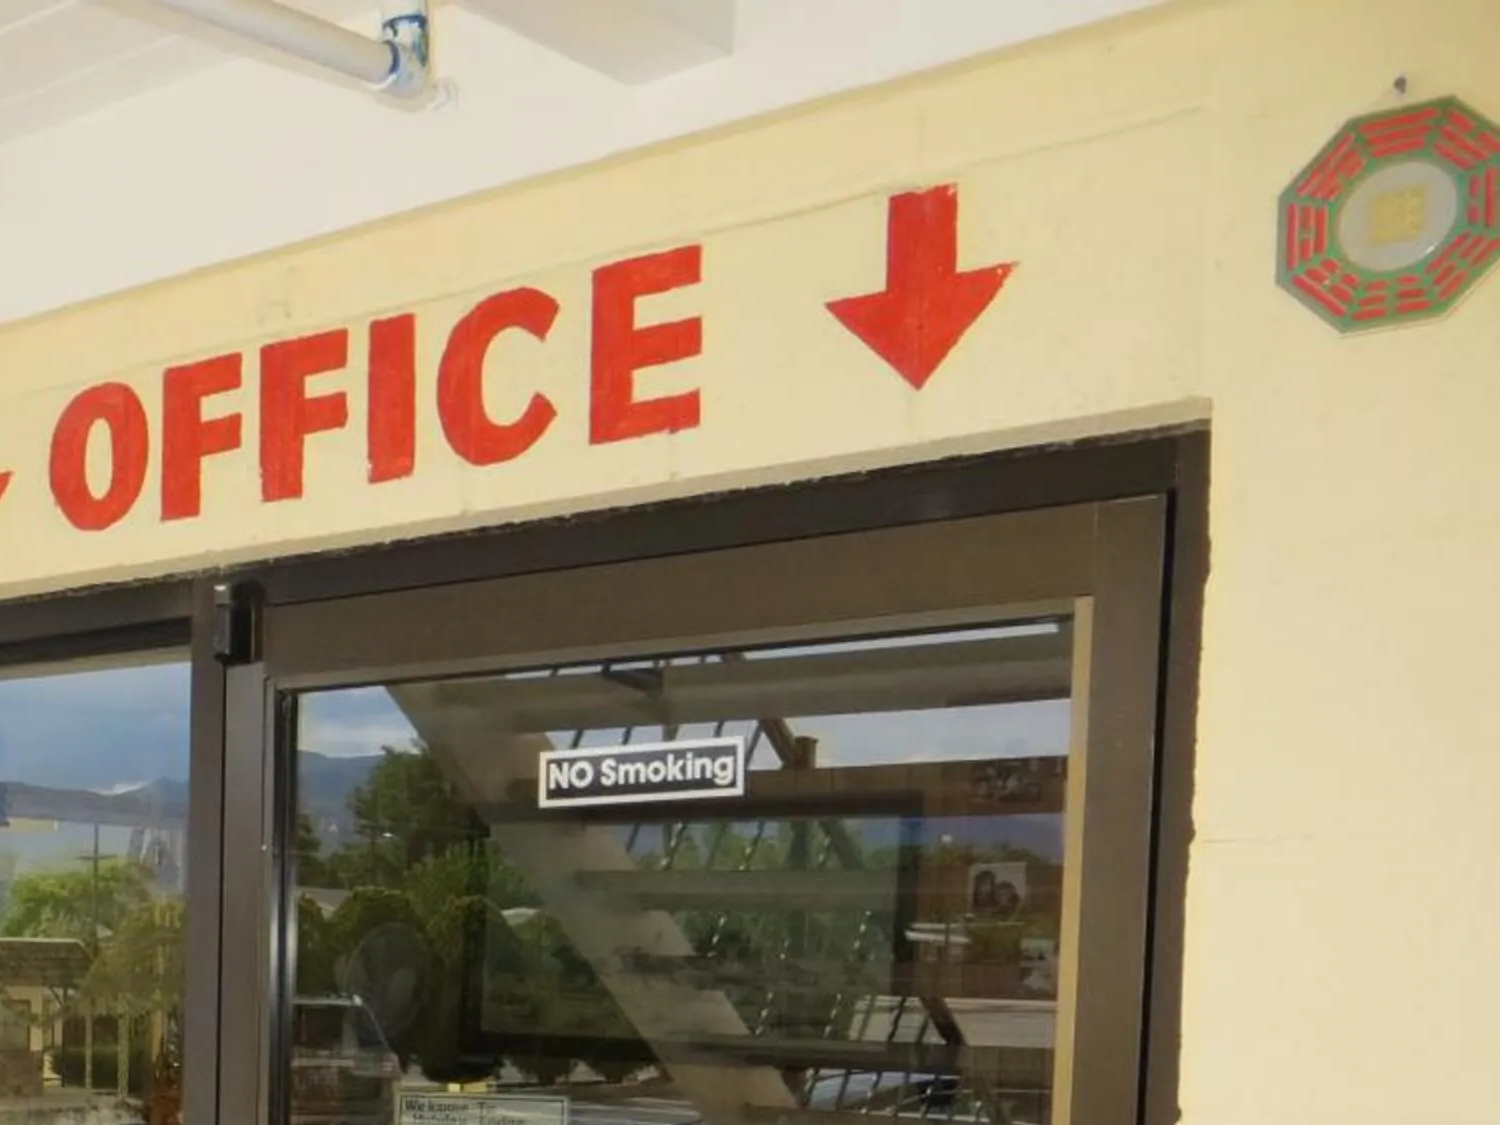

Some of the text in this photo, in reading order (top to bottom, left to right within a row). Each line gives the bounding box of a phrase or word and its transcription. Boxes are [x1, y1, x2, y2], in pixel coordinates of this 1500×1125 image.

[48, 244, 702, 532] OFFICE
[550, 752, 735, 789] NO Smoking
